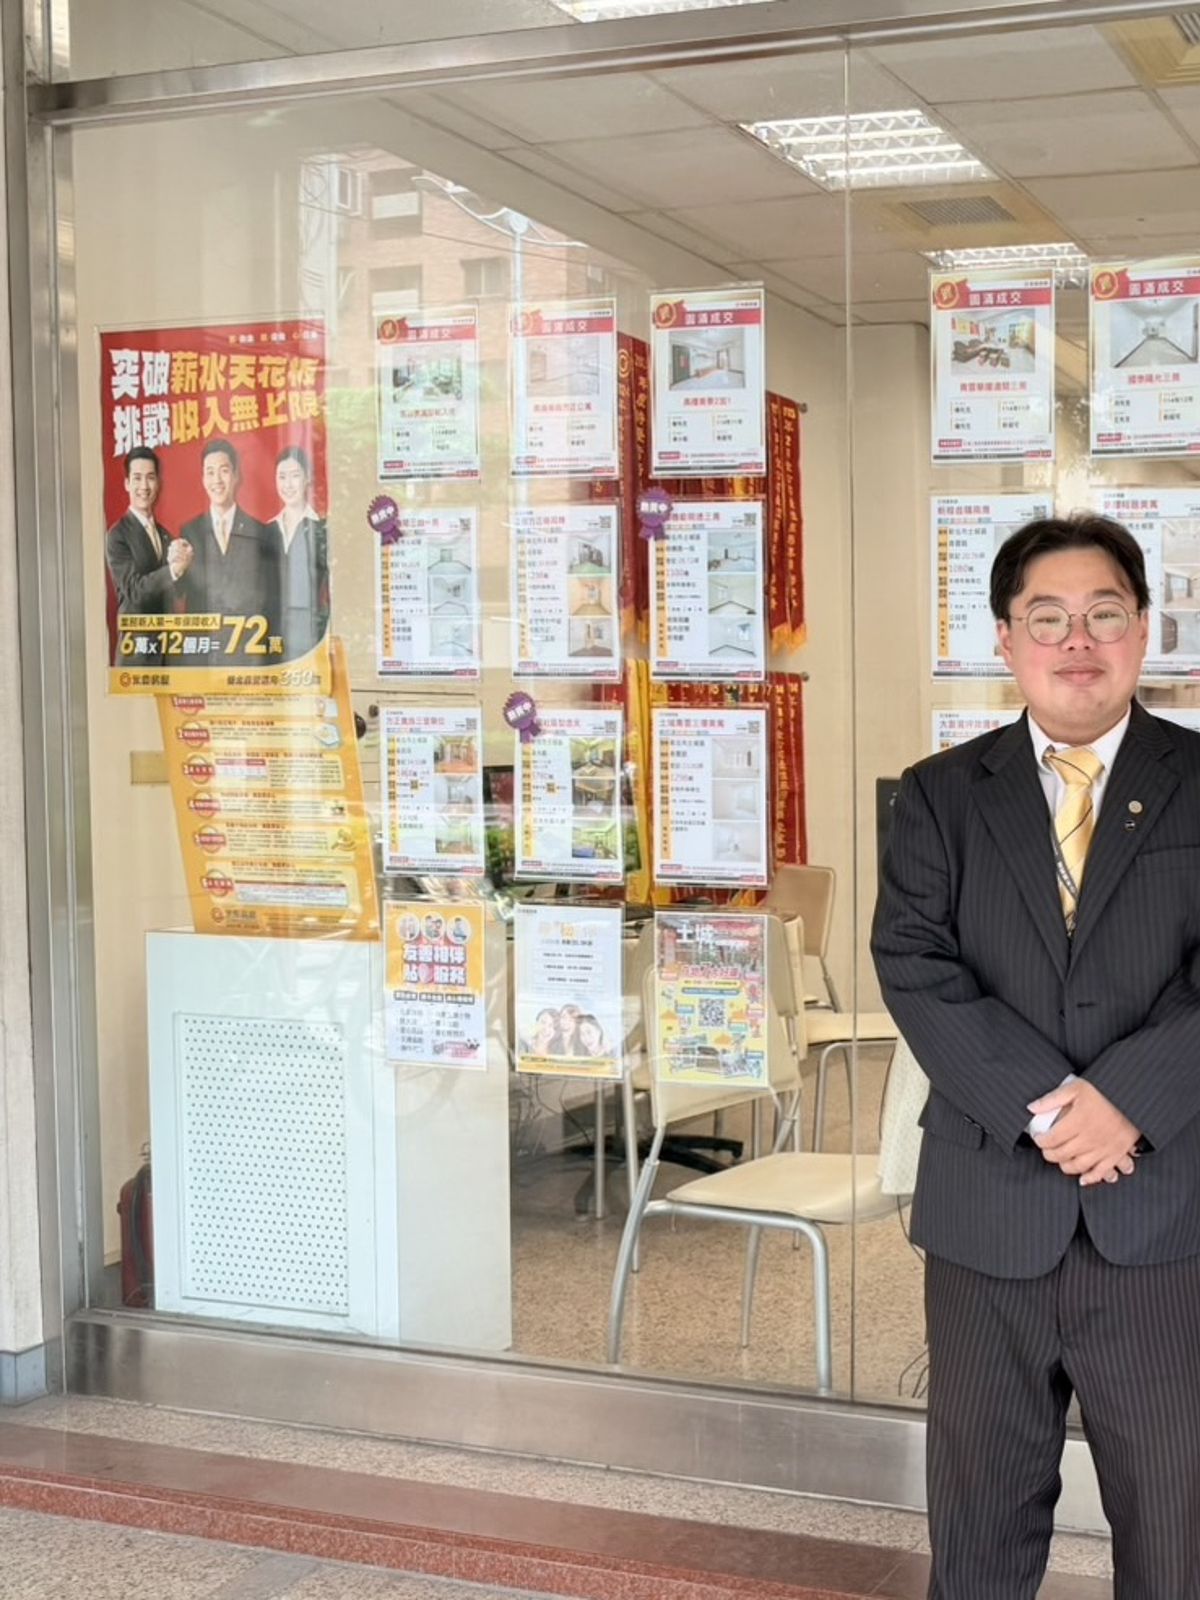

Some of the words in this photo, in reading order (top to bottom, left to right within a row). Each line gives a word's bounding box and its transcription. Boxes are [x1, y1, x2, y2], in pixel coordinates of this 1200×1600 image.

[109, 348, 320, 400] 突破薪水天花板
[113, 389, 321, 458] 挑戰收入無上限
